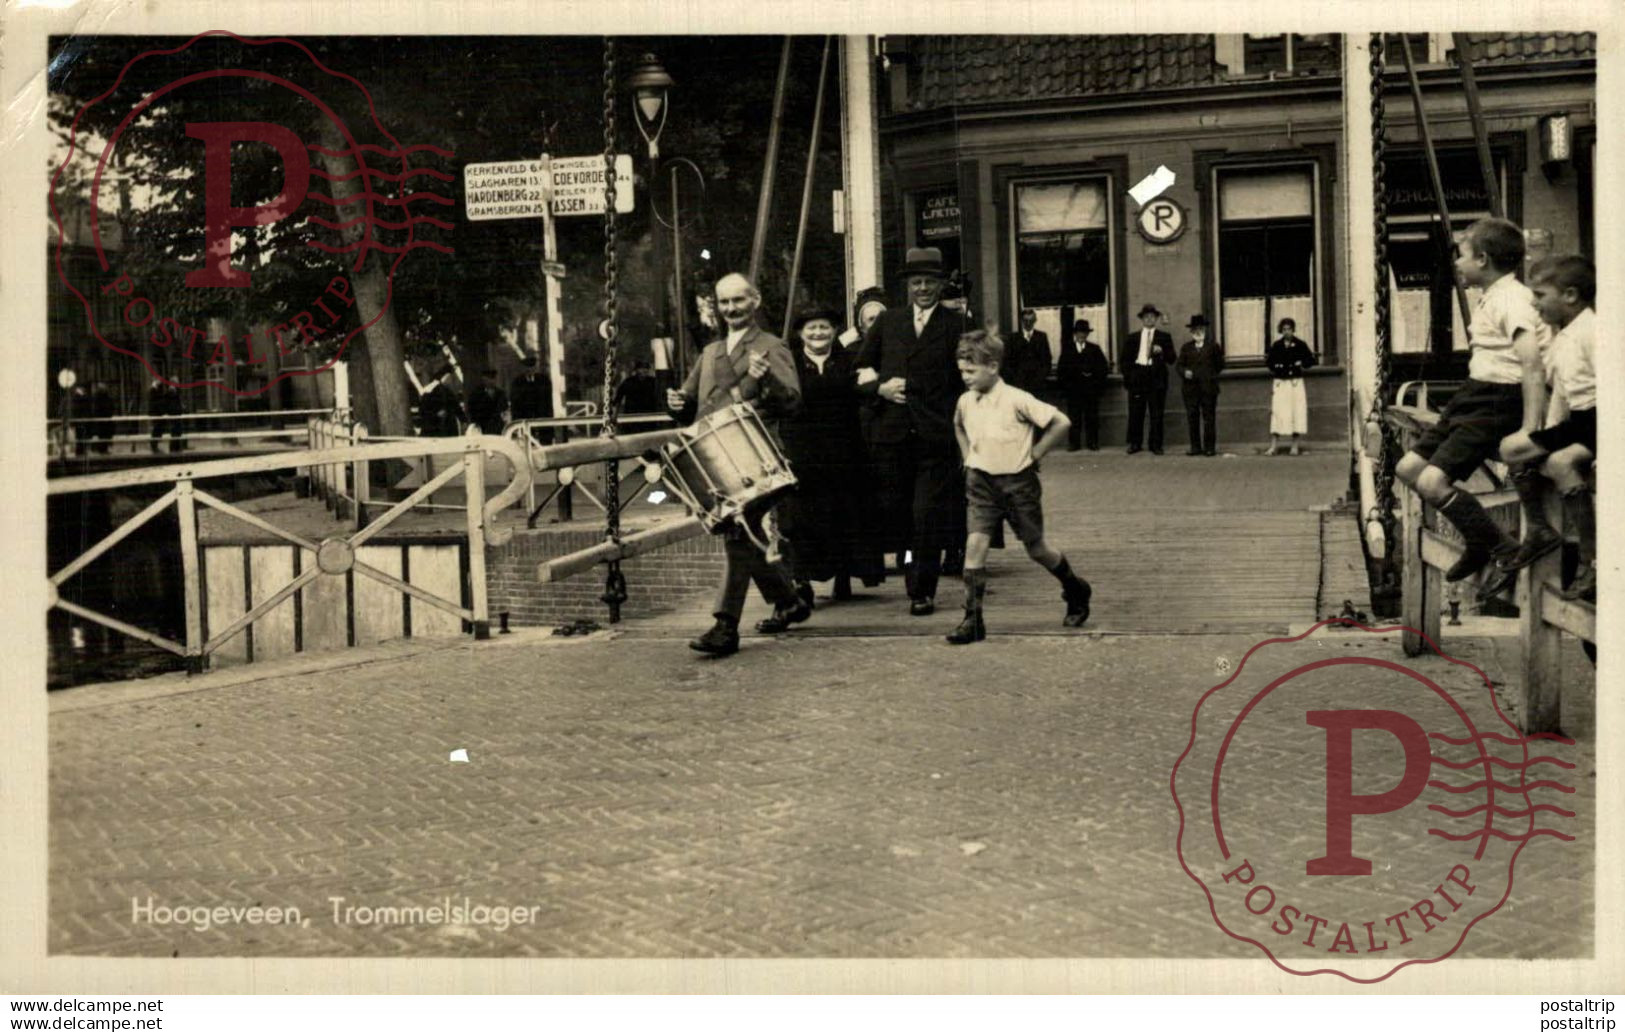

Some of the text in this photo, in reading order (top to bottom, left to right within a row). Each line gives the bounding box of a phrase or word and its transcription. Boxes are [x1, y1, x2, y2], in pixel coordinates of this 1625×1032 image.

[467, 164, 526, 176] KERKENVELD
[468, 177, 527, 189] SLAGHAREN
[553, 170, 606, 186] COEVORDE
[467, 189, 527, 204] HARDENBERG
[468, 205, 531, 217] GRAMSBERGEN
[554, 198, 585, 213] ASSEN
